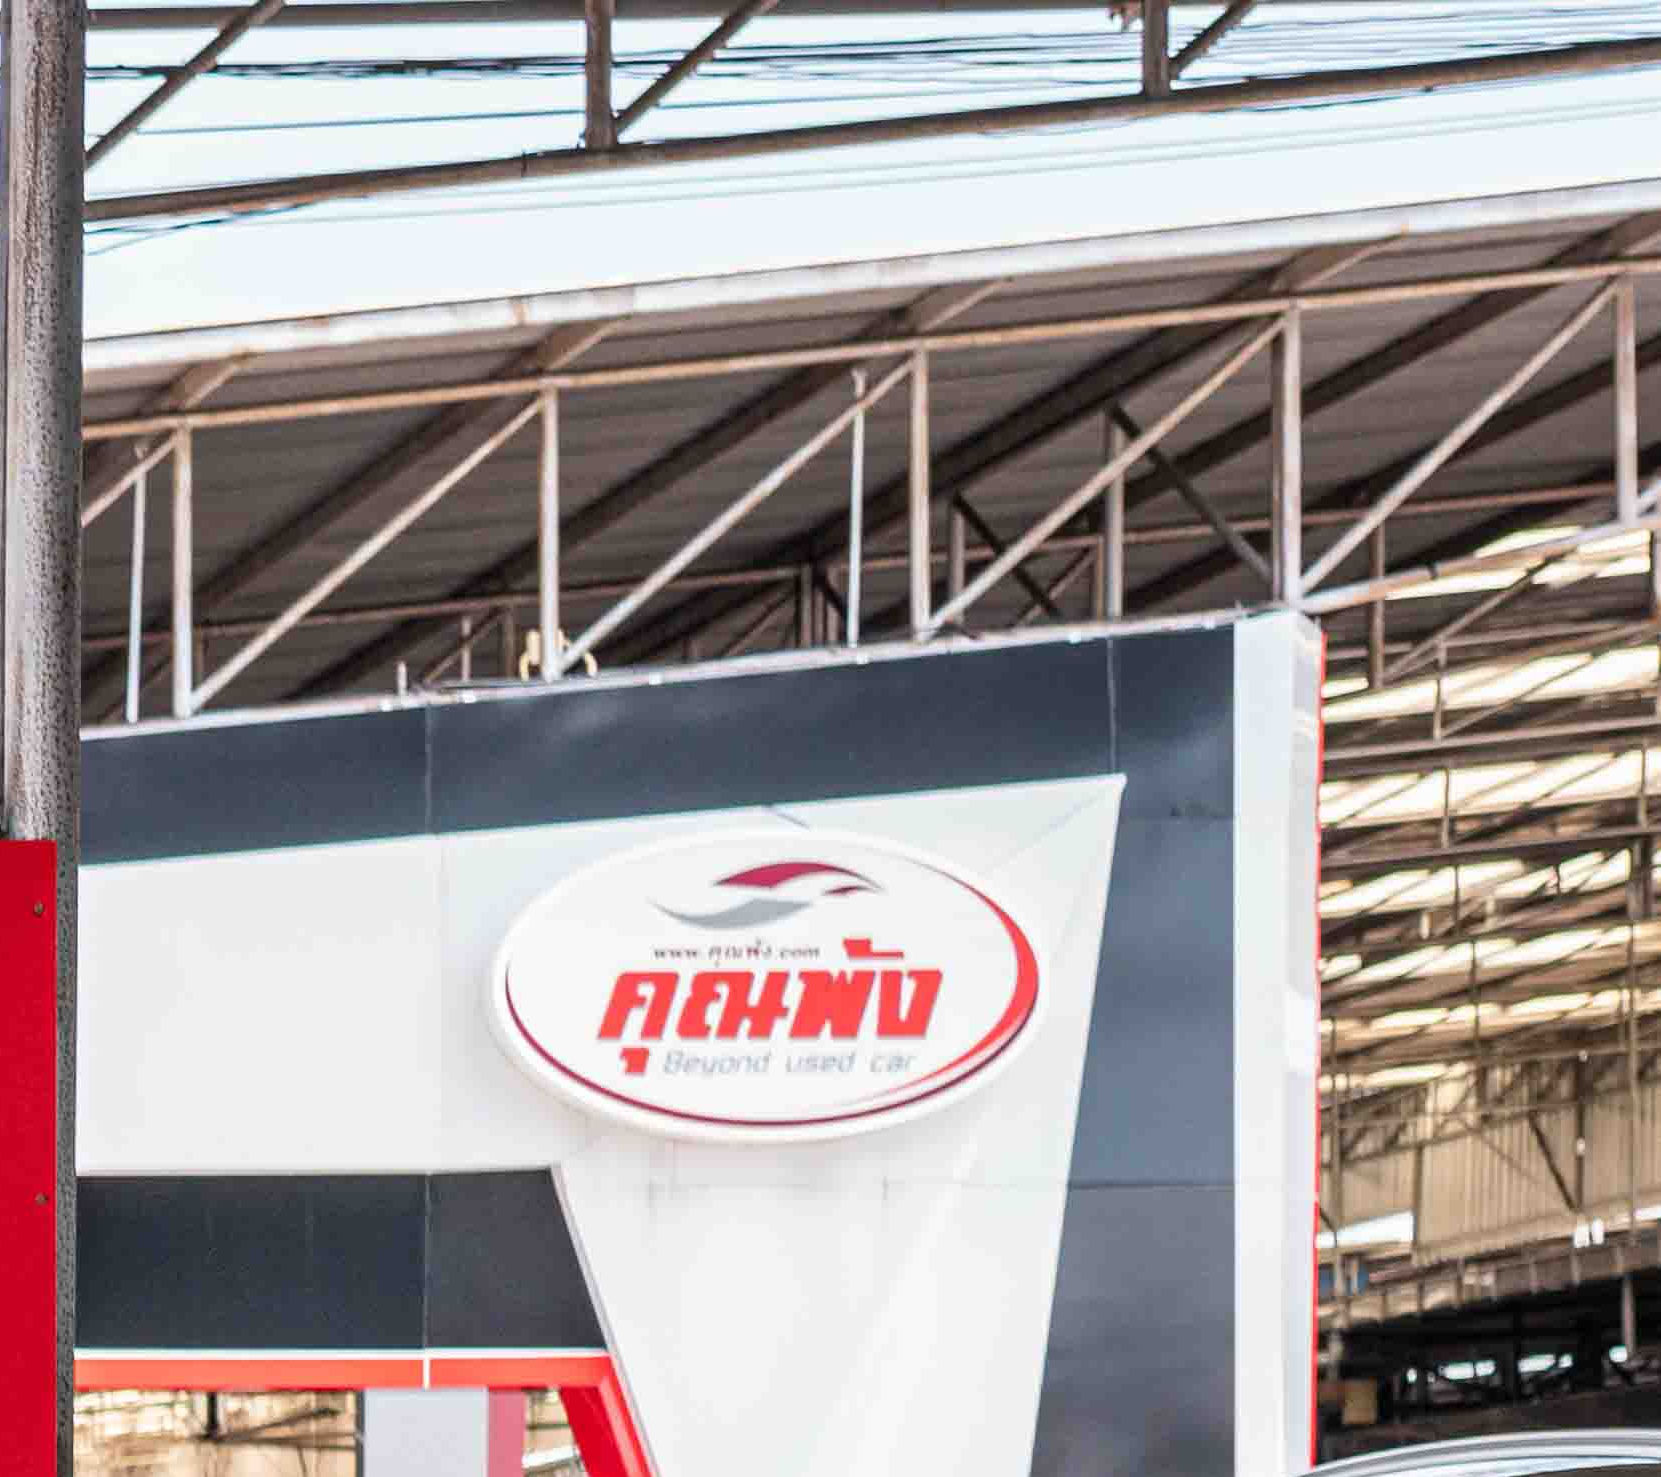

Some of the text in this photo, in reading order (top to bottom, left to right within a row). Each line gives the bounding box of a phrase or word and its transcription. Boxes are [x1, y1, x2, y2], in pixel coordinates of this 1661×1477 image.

[664, 1049, 916, 1076] Beyond used car
